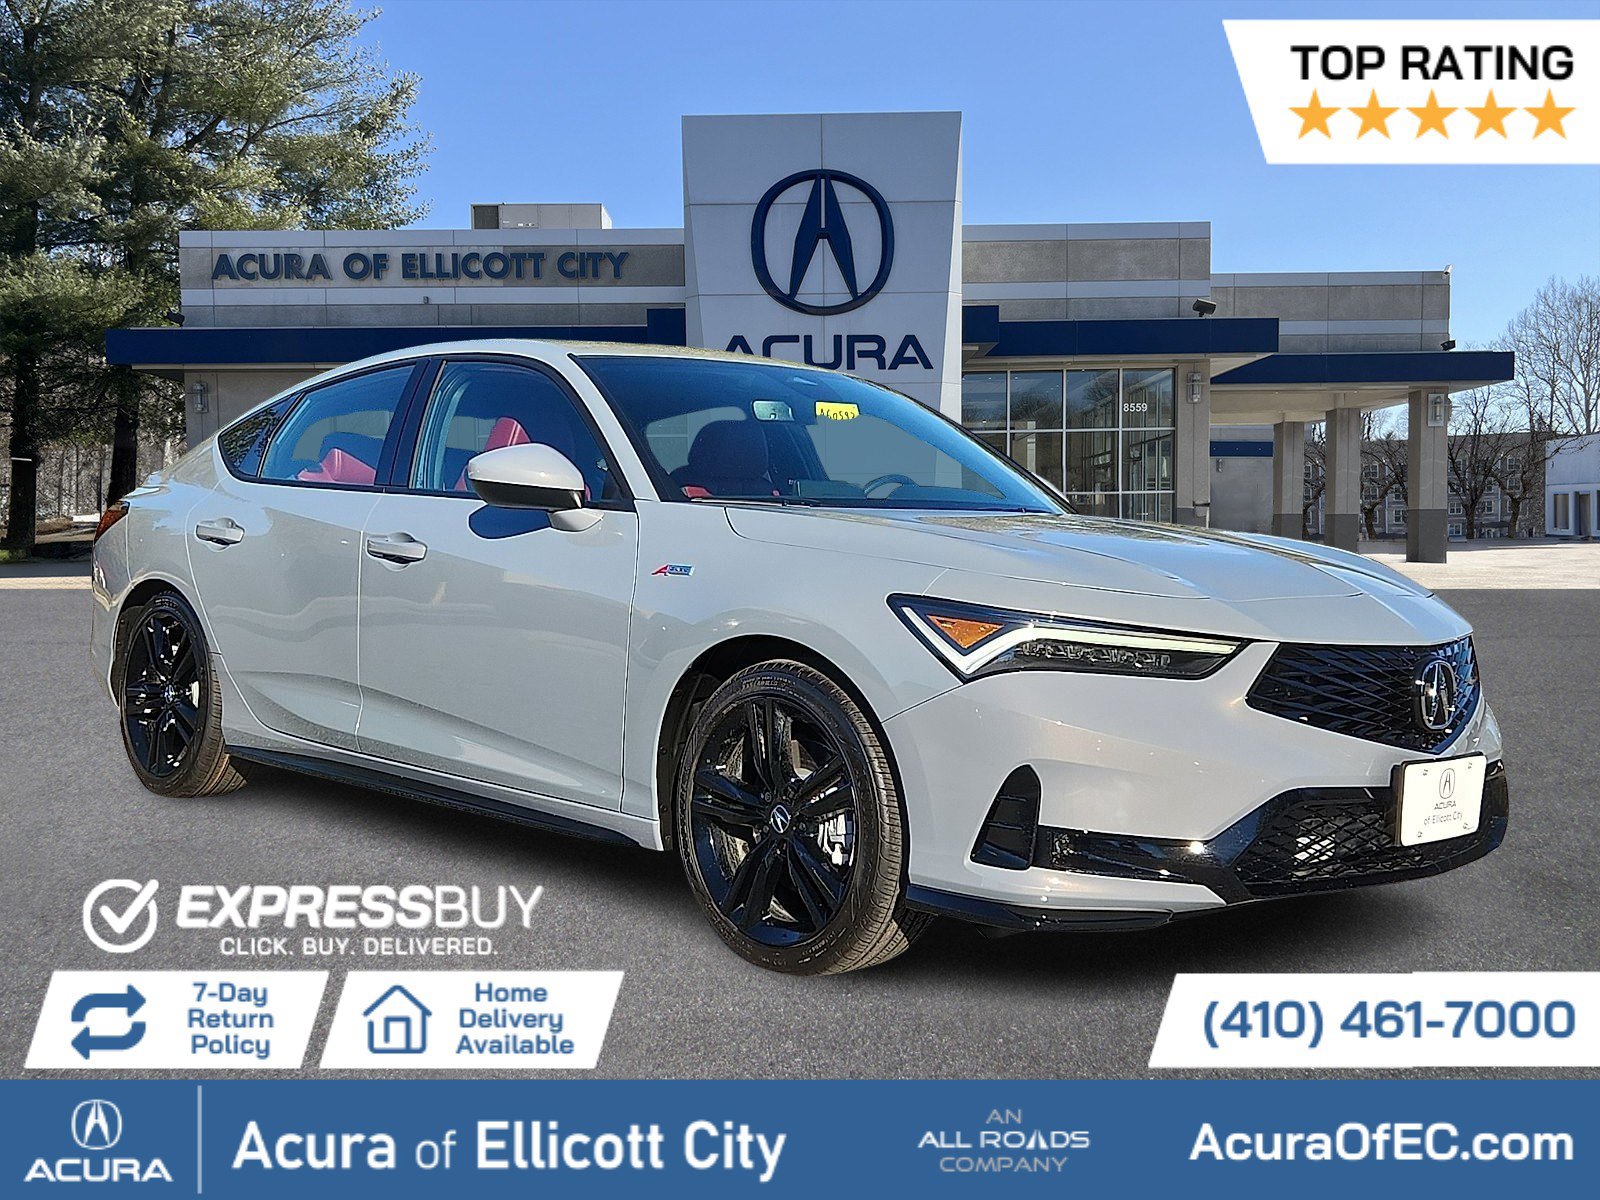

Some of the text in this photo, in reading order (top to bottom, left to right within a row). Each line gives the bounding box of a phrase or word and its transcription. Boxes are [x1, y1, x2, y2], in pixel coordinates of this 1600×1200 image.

[212, 252, 629, 281] ACURA OF ELLICOTT CITY
[1123, 402, 1148, 413] 8559
